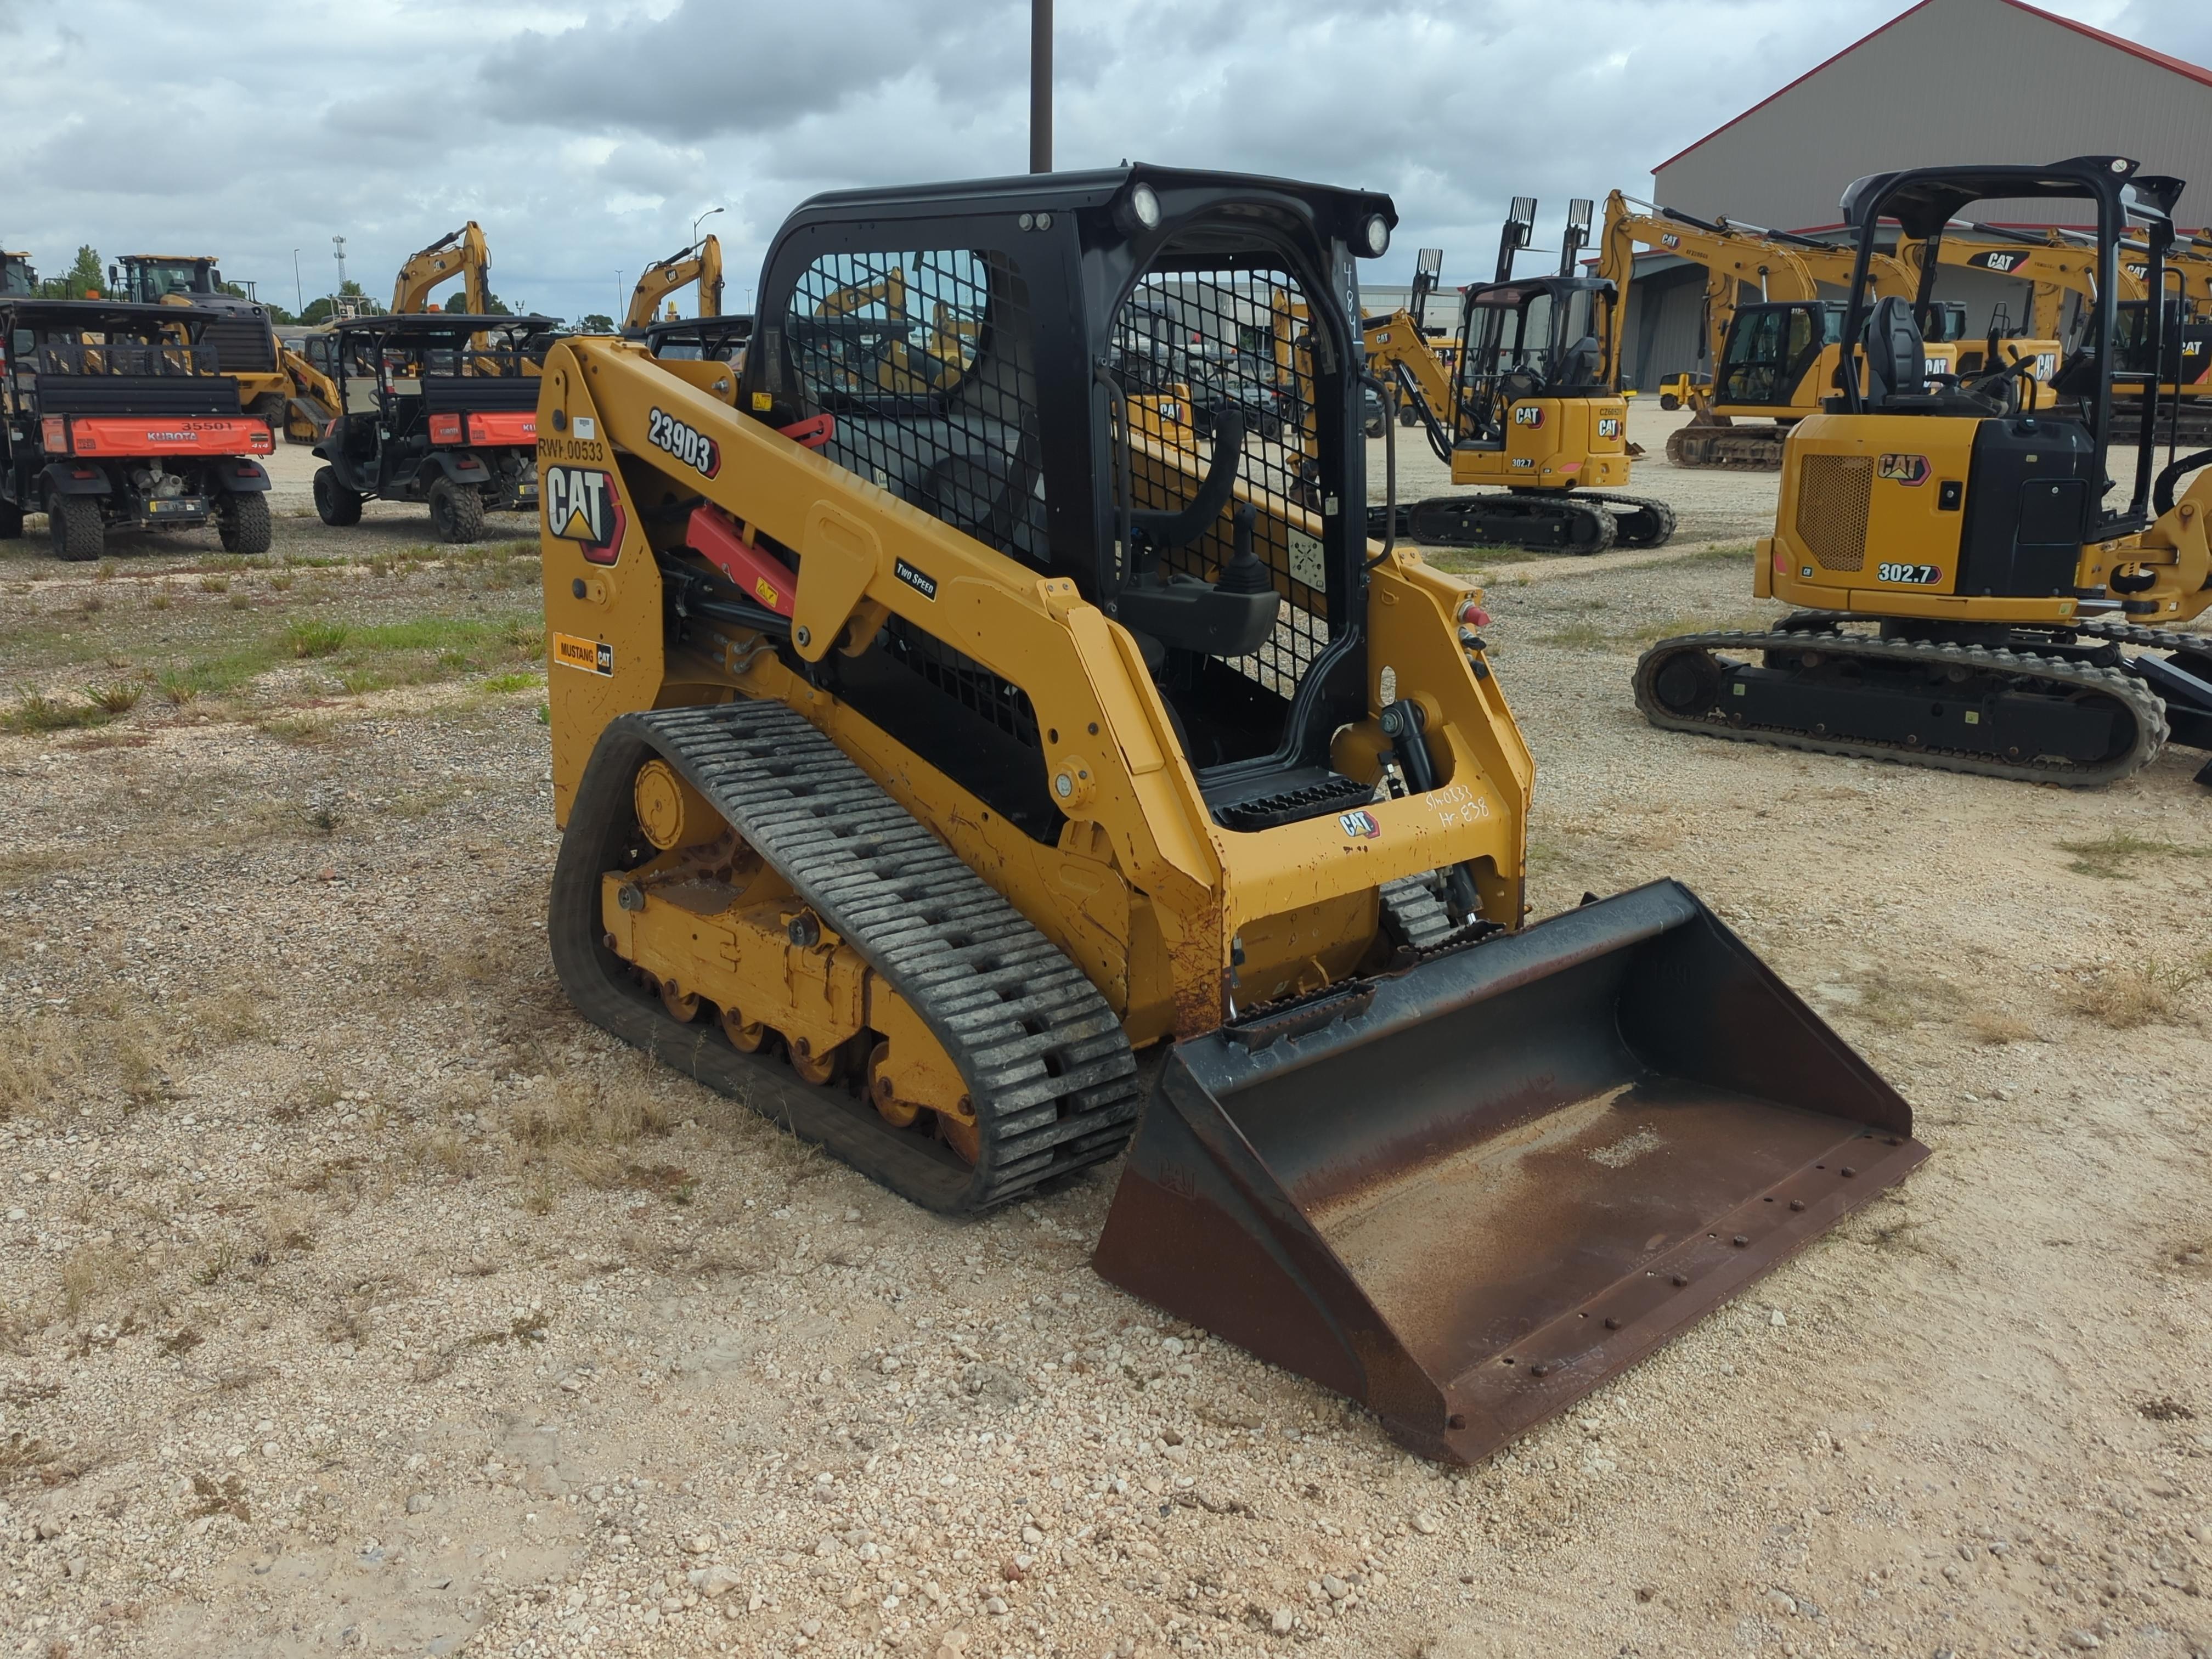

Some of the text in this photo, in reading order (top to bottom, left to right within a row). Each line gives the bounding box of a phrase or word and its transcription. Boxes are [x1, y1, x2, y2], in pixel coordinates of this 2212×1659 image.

[1661, 234, 1678, 246] CAT
[1987, 253, 2014, 271] CAT
[1376, 333, 1388, 344] CAT
[2037, 354, 2055, 380] CAT
[1516, 408, 1538, 424] CAT
[182, 422, 232, 431] 35501
[1599, 420, 1616, 436] CAT
[147, 432, 198, 441] KUBOTA
[649, 409, 710, 472] 239D3
[1512, 459, 1532, 467] 302.7
[1878, 455, 1920, 479] CAT
[548, 467, 603, 541] CAT
[1878, 563, 1931, 583] 302.7
[561, 642, 610, 667] MUSTANG CAT
[1339, 812, 1372, 836] CAT
